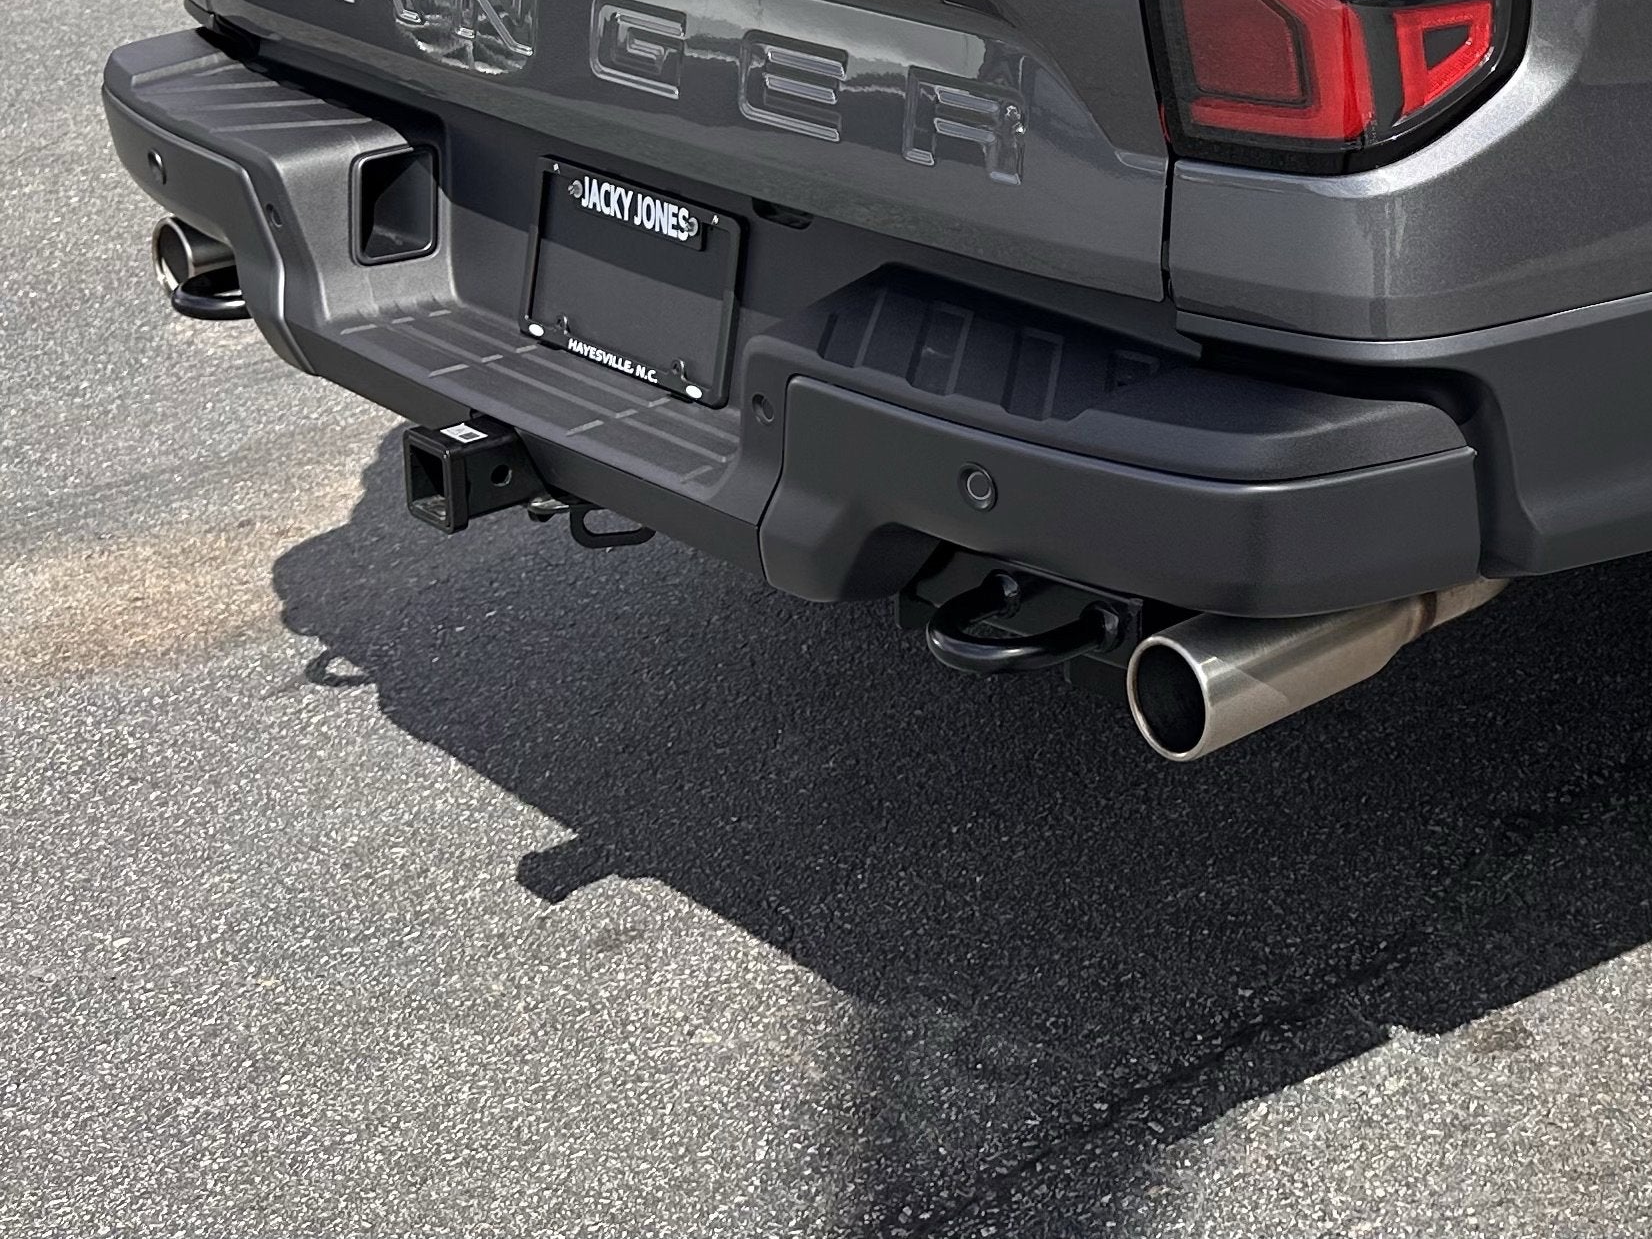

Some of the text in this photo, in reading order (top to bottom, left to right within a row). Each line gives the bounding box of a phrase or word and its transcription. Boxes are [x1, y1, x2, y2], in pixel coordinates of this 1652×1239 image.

[581, 176, 690, 241] JACKY JONES
[567, 338, 658, 383] HAYESVILLE, N.C.
